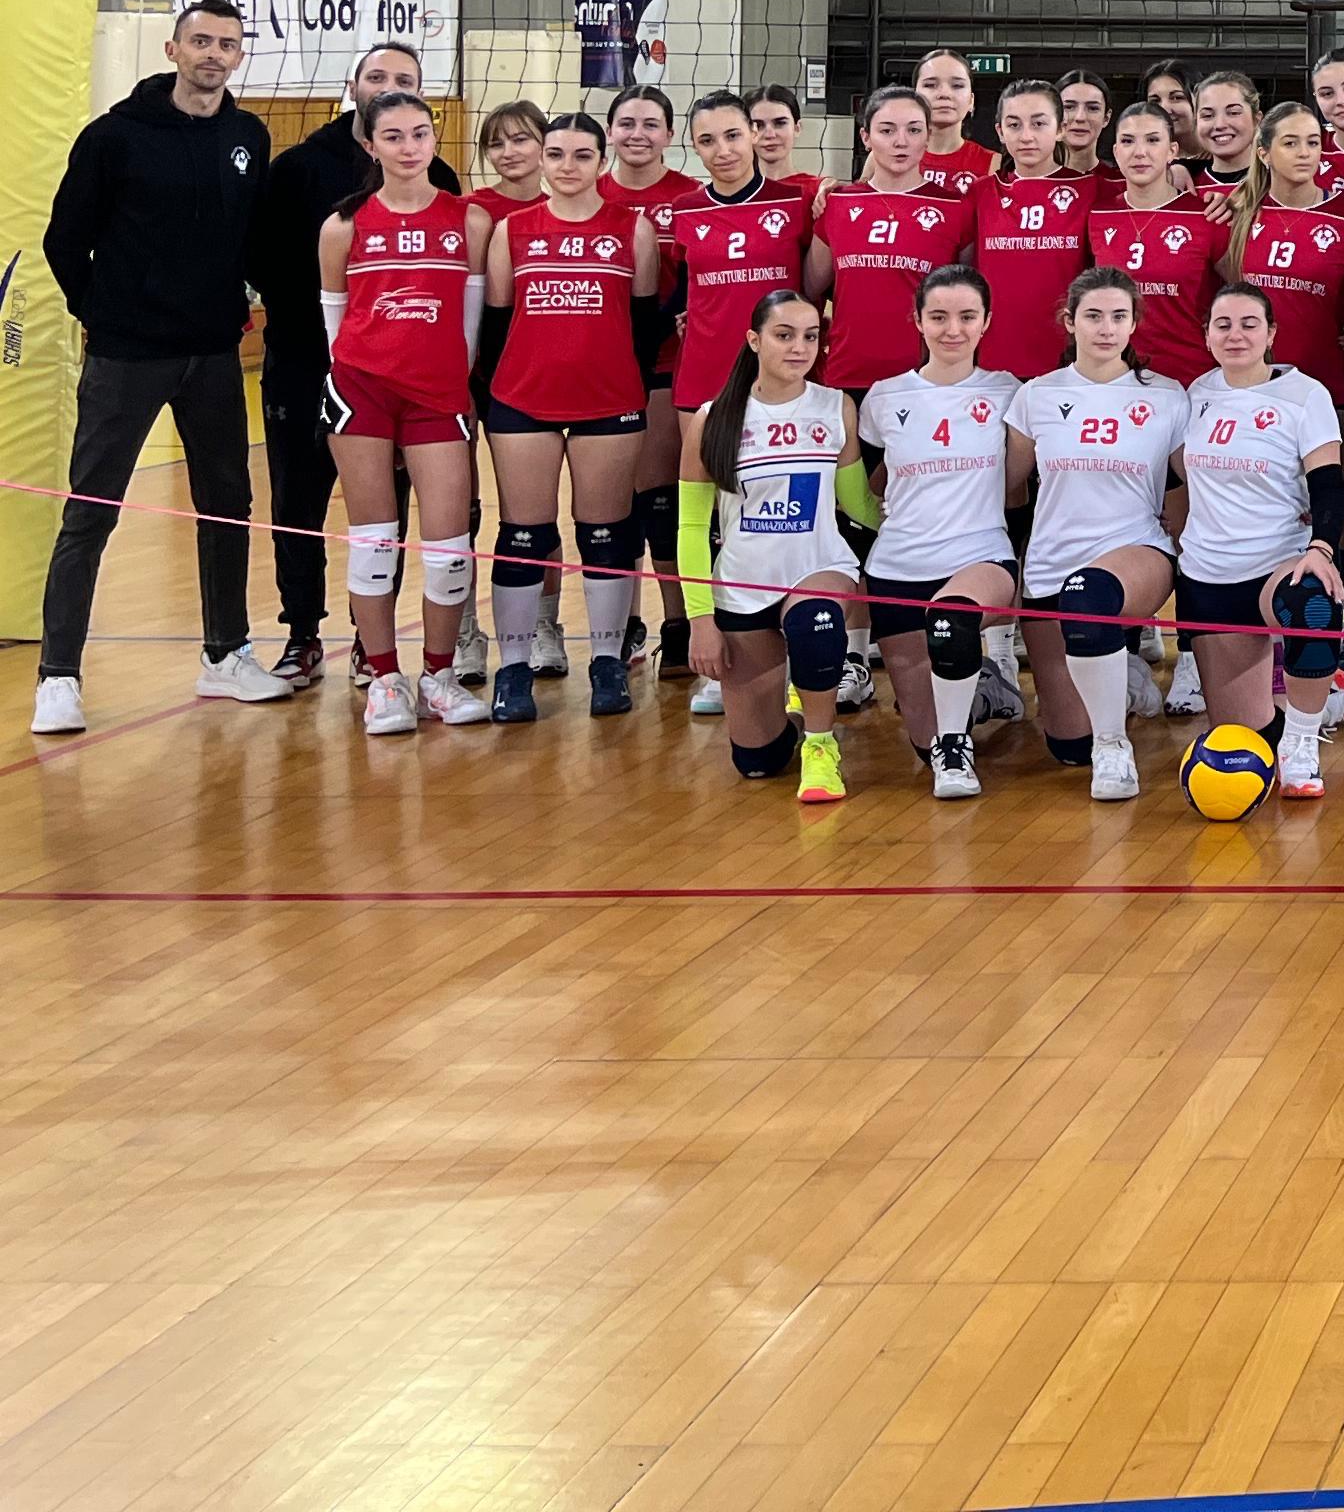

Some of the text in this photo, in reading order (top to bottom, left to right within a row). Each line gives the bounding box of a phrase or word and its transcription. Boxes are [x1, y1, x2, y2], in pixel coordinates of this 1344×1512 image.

[1019, 205, 1044, 230] 18
[397, 230, 425, 253] 69
[867, 220, 899, 244] 21
[558, 237, 584, 257] 48
[728, 231, 746, 259] 2
[984, 236, 1079, 250] MANIFATTURE LEONE SRL
[836, 254, 919, 271] MANIFATTURE LEONE
[1126, 242, 1145, 270] 3
[1267, 240, 1296, 268] 13
[696, 268, 747, 286] MANIFATTURE
[748, 267, 775, 282] LEONE
[1285, 276, 1313, 293] LEONE
[526, 280, 603, 294] AUTOMA
[1140, 282, 1180, 297] LEONE SRL
[767, 422, 797, 447] 20
[931, 418, 950, 447] 4
[1079, 418, 1119, 445] 23
[1208, 418, 1237, 445] 10
[954, 456, 985, 471] LEONE
[1044, 457, 1136, 474] MANIFATTURE LEONE
[1222, 455, 1269, 474] LEONE SRL
[759, 500, 802, 516] ARS
[742, 519, 798, 532] AUTOMAZIONE
